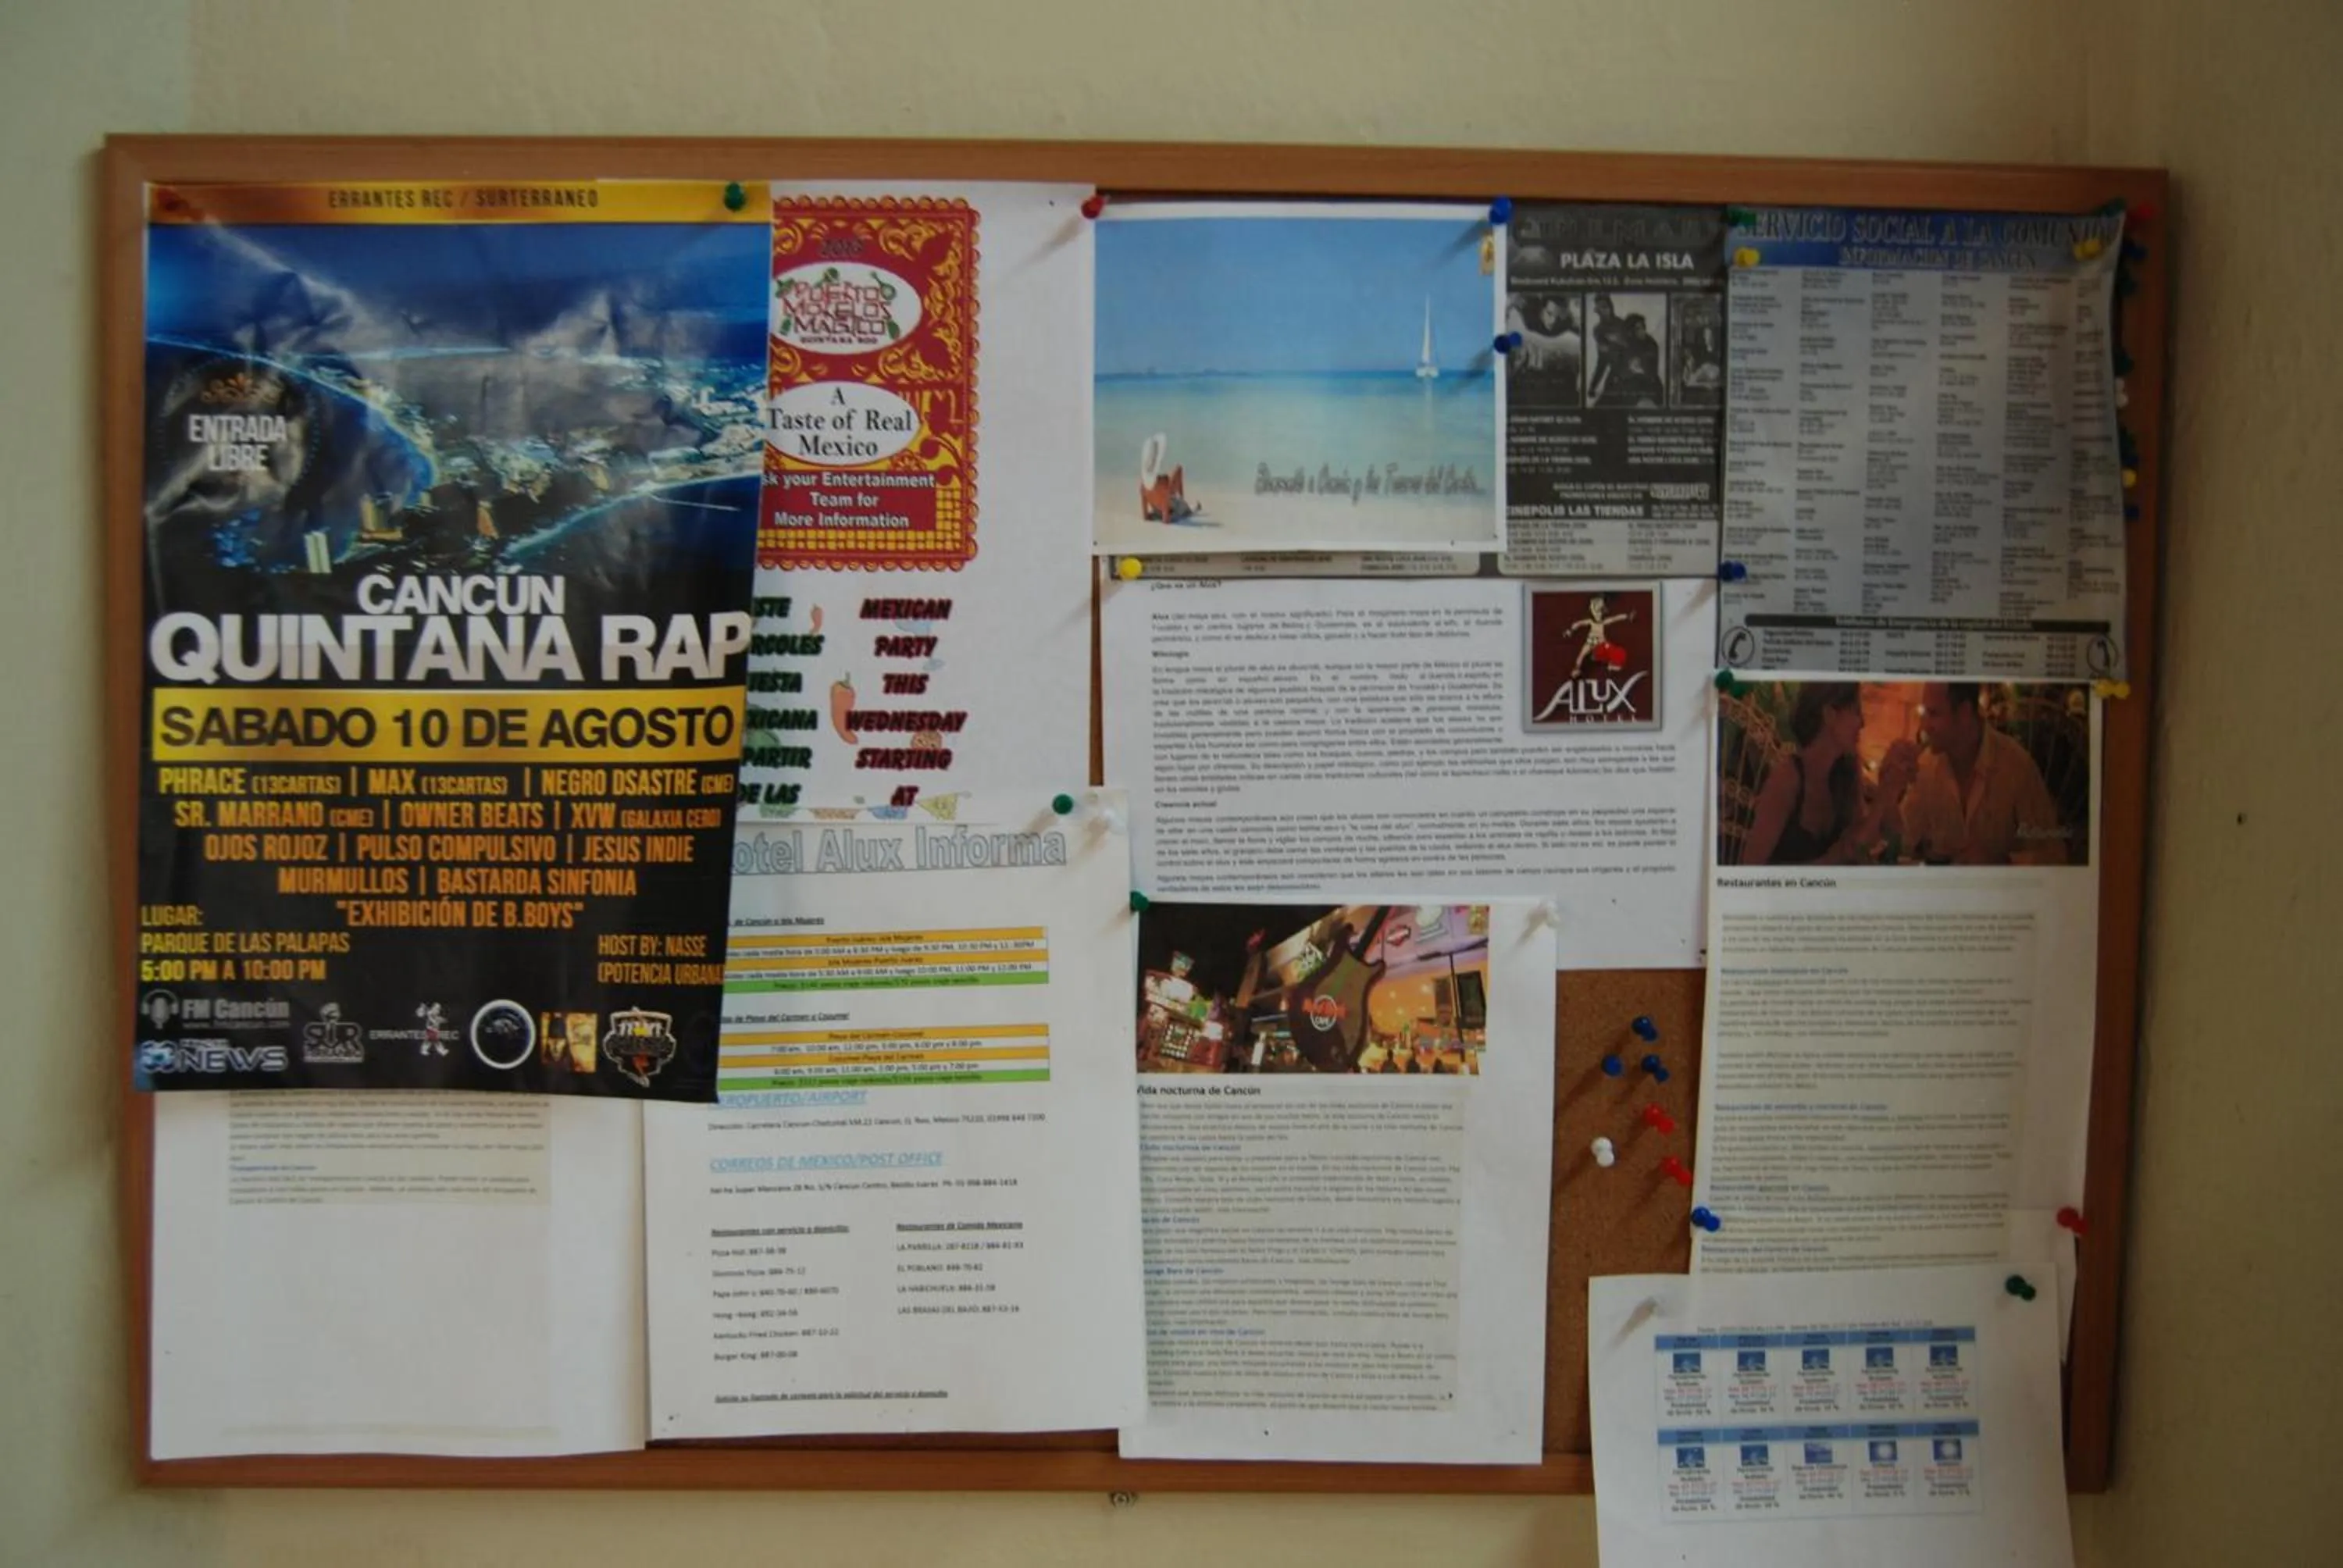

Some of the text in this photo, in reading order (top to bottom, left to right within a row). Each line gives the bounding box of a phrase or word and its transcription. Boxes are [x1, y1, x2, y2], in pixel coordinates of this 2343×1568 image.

[329, 189, 415, 208] ERRANTES
[420, 190, 455, 208] REC
[1851, 216, 1934, 244] SOCIAL
[1560, 251, 1694, 270] PLAZA LA ISLA
[830, 387, 846, 405] A
[188, 415, 287, 444] ENTRADA
[766, 407, 912, 431] Taste of Real
[798, 433, 879, 458] Mexico
[208, 444, 269, 472] LIBRE
[761, 471, 936, 491] sk your Entertainment
[809, 492, 880, 508] Team for
[775, 511, 910, 529] More Information
[752, 597, 791, 618] STE
[859, 597, 953, 620] MEXICAN
[150, 611, 753, 685] QUINTANA RAP
[749, 634, 825, 657] RCOLES
[874, 636, 938, 657] PARTY
[747, 671, 803, 694] IESTA
[883, 673, 930, 695] THIS
[1532, 670, 1649, 722] ALUX
[160, 704, 735, 749] SABADO 10 DE AGOSTO
[746, 708, 818, 731] XICANA
[844, 710, 968, 732] WEDNESDAY
[854, 747, 954, 772] STARTING
[159, 766, 248, 794] PHRACE
[368, 768, 416, 794] MAX
[540, 768, 607, 796] NEGRO
[612, 768, 697, 796] DSASTRE
[764, 782, 803, 805] LAS
[890, 785, 920, 808] AT
[174, 800, 212, 828] SR.
[217, 800, 324, 829] MARRANO
[399, 801, 474, 829] OWNER
[480, 801, 544, 829] BEATS
[570, 802, 616, 829] XVW
[204, 833, 695, 863] OJOS ROJOZ PULSO COMPULSIVO JESUS INDIE
[729, 824, 1067, 875] otel Alux Informa
[277, 867, 637, 896] MURMULLOS BASTARDA SINFONIA
[1717, 876, 1837, 889] Restaurantes en Cancún
[141, 904, 204, 927] LUGAR:
[336, 896, 584, 929] "EXHIBICIÓN DE B.BOYS"
[141, 932, 351, 954] PARQUE DE LAS PALAPAS
[597, 934, 636, 957] HOST
[640, 935, 663, 957] BY:
[665, 935, 708, 957] NASSE
[141, 959, 327, 982] 5:00 PM A 10:00 PM
[181, 997, 291, 1020] FM Cancún
[175, 1045, 289, 1074] NEWS
[1160, 1085, 1206, 1096] nocturna
[1208, 1085, 1221, 1096] de
[1224, 1085, 1262, 1096] Cancún
